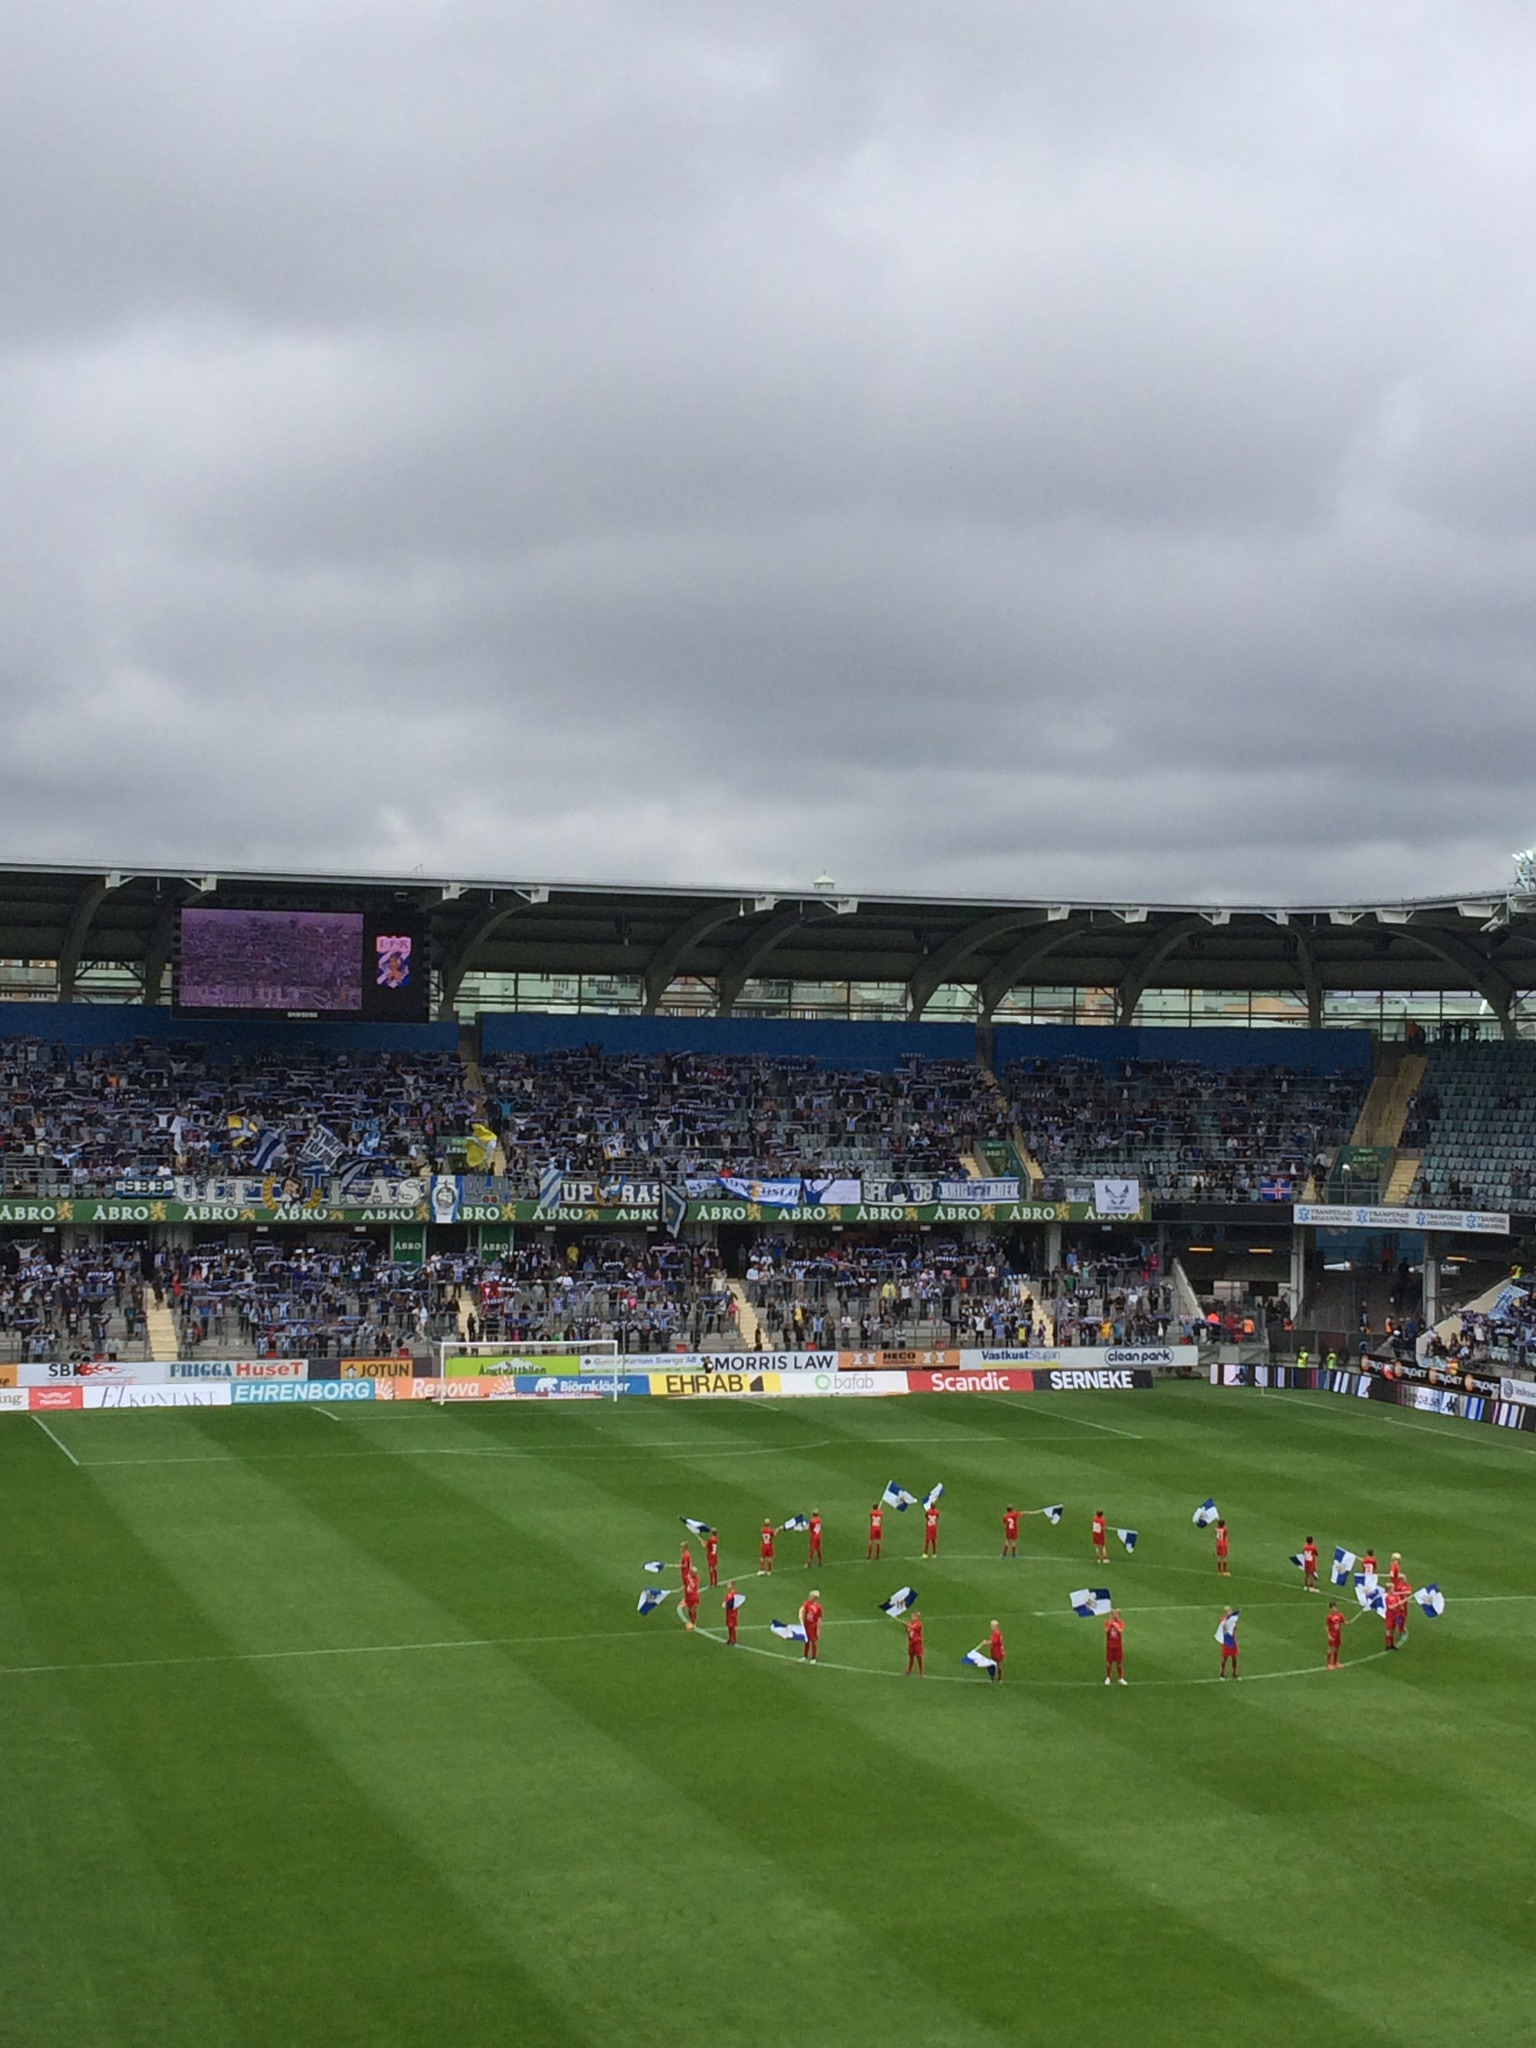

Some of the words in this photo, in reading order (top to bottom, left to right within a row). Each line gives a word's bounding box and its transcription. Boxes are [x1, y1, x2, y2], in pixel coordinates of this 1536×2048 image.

[0, 1204, 56, 1221] ÅBRO
[92, 1204, 149, 1221] ÅBRO
[183, 1205, 238, 1221] ÅBRO
[696, 1205, 746, 1221] ÅBRO
[777, 1206, 826, 1221] ÅBRO
[856, 1205, 904, 1221] ÅBRO
[933, 1205, 981, 1221] ÅBRO
[1009, 1205, 1055, 1221] ÅBRO
[715, 1355, 787, 1371] MORRIS
[793, 1354, 834, 1370] LAW
[1107, 1350, 1139, 1362] clean
[1141, 1349, 1171, 1364] park
[170, 1363, 232, 1377] FRIGGA
[360, 1363, 410, 1377] JOTUN
[411, 1379, 480, 1398] Renova
[665, 1374, 744, 1394] EHRAB
[833, 1373, 874, 1390] bafab
[930, 1371, 1011, 1392] Scandic
[1049, 1370, 1134, 1391] SERNEKE
[129, 1391, 217, 1407] KONTAKT
[234, 1381, 371, 1402] EHRENBORG
